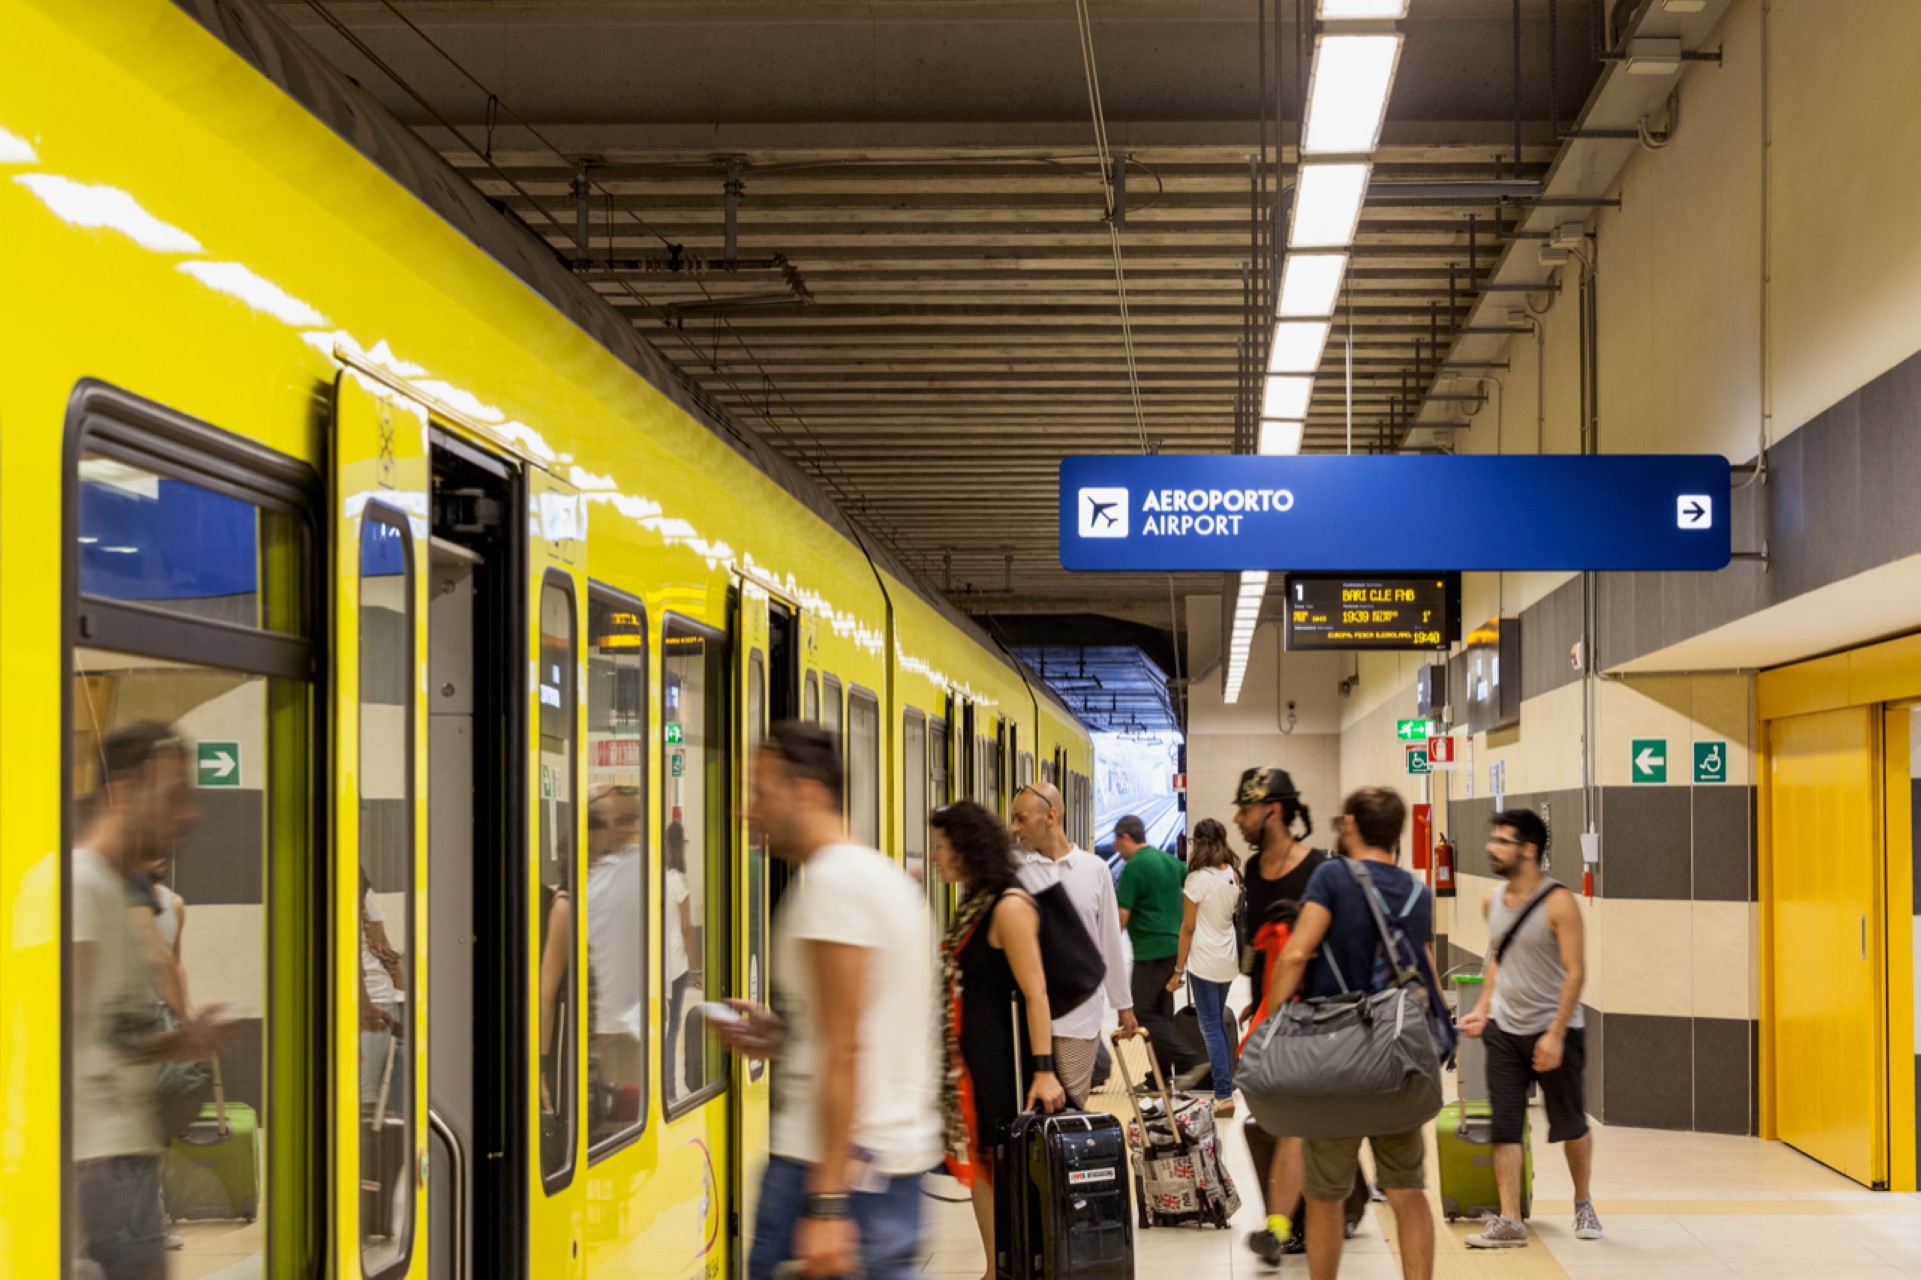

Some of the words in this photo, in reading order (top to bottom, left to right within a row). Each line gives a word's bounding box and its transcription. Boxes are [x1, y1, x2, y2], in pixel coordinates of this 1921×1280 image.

[1142, 489, 1294, 512] AEROPORTO
[1142, 515, 1243, 536] AIRPORT
[1295, 584, 1304, 601] 1
[1342, 588, 1367, 602] BARI
[1413, 632, 1440, 645] 19:40
